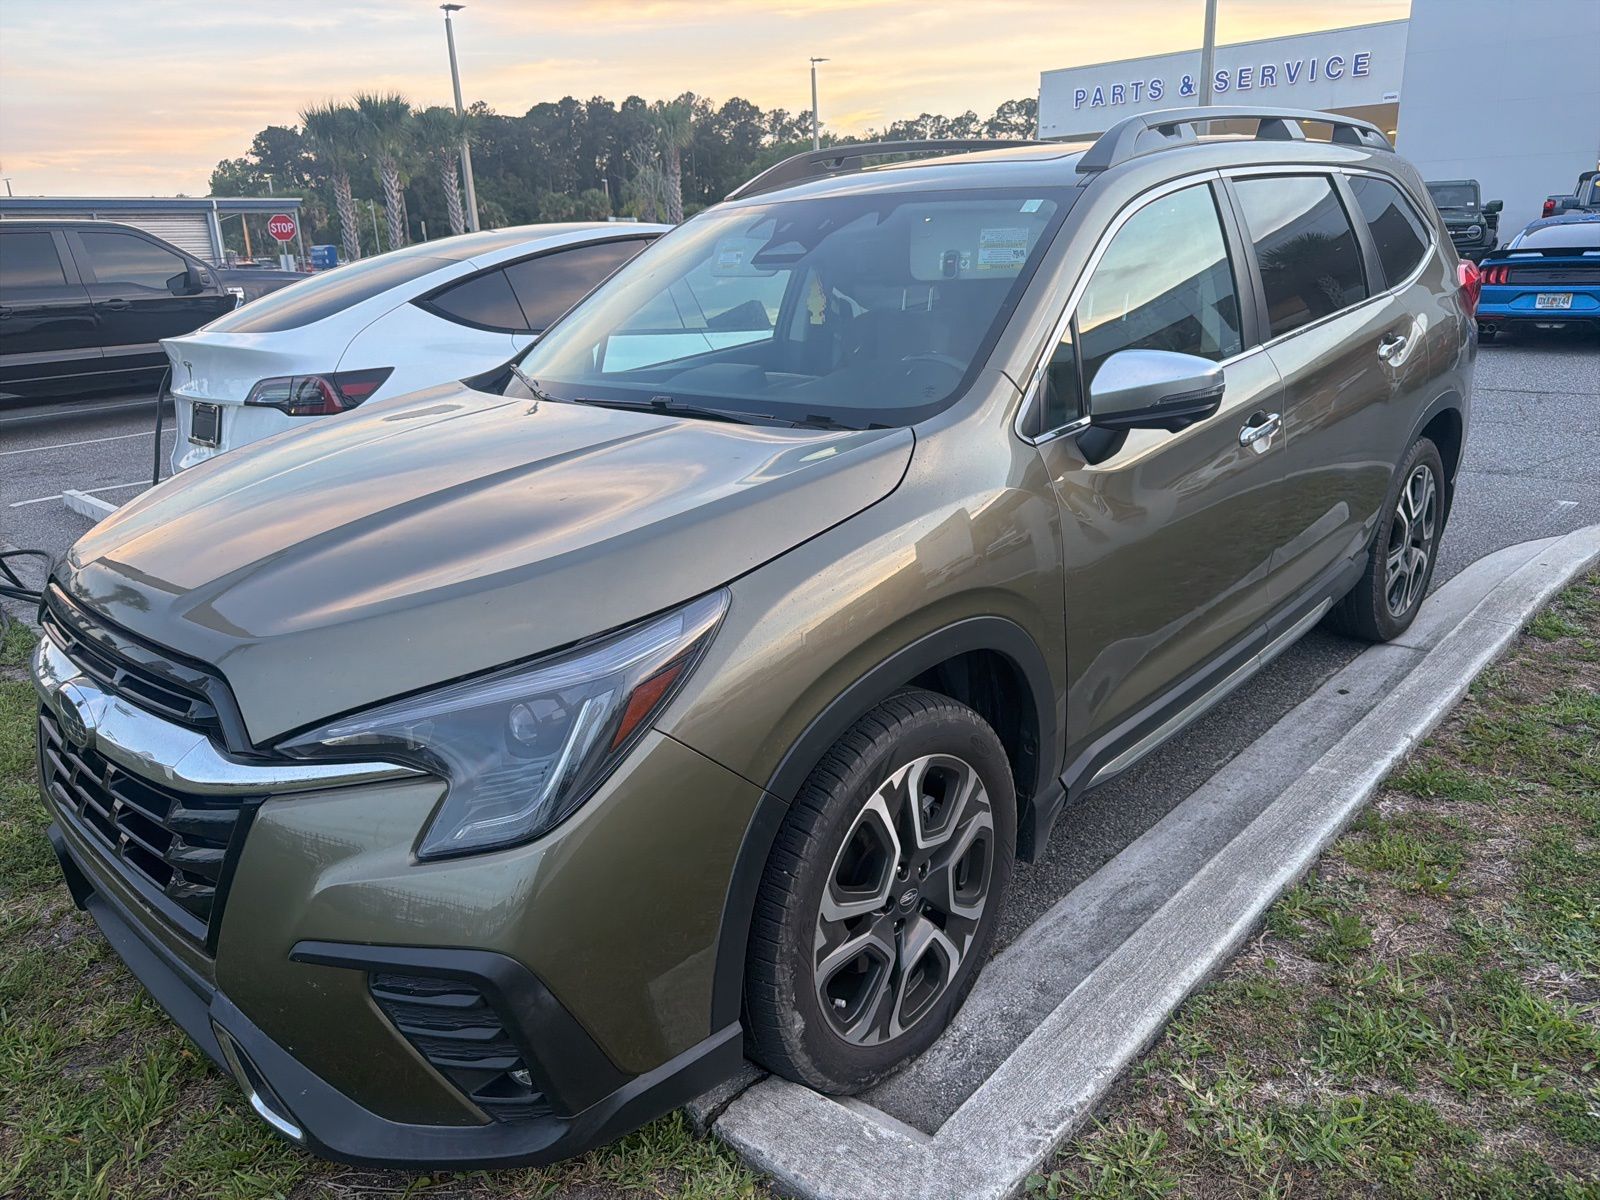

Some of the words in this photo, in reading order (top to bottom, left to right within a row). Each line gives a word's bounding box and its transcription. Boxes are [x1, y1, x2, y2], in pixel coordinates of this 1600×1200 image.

[1073, 78, 1163, 108] PARTS
[1179, 74, 1196, 97] &
[1213, 52, 1370, 93] SERVICE
[271, 223, 294, 233] STOP
